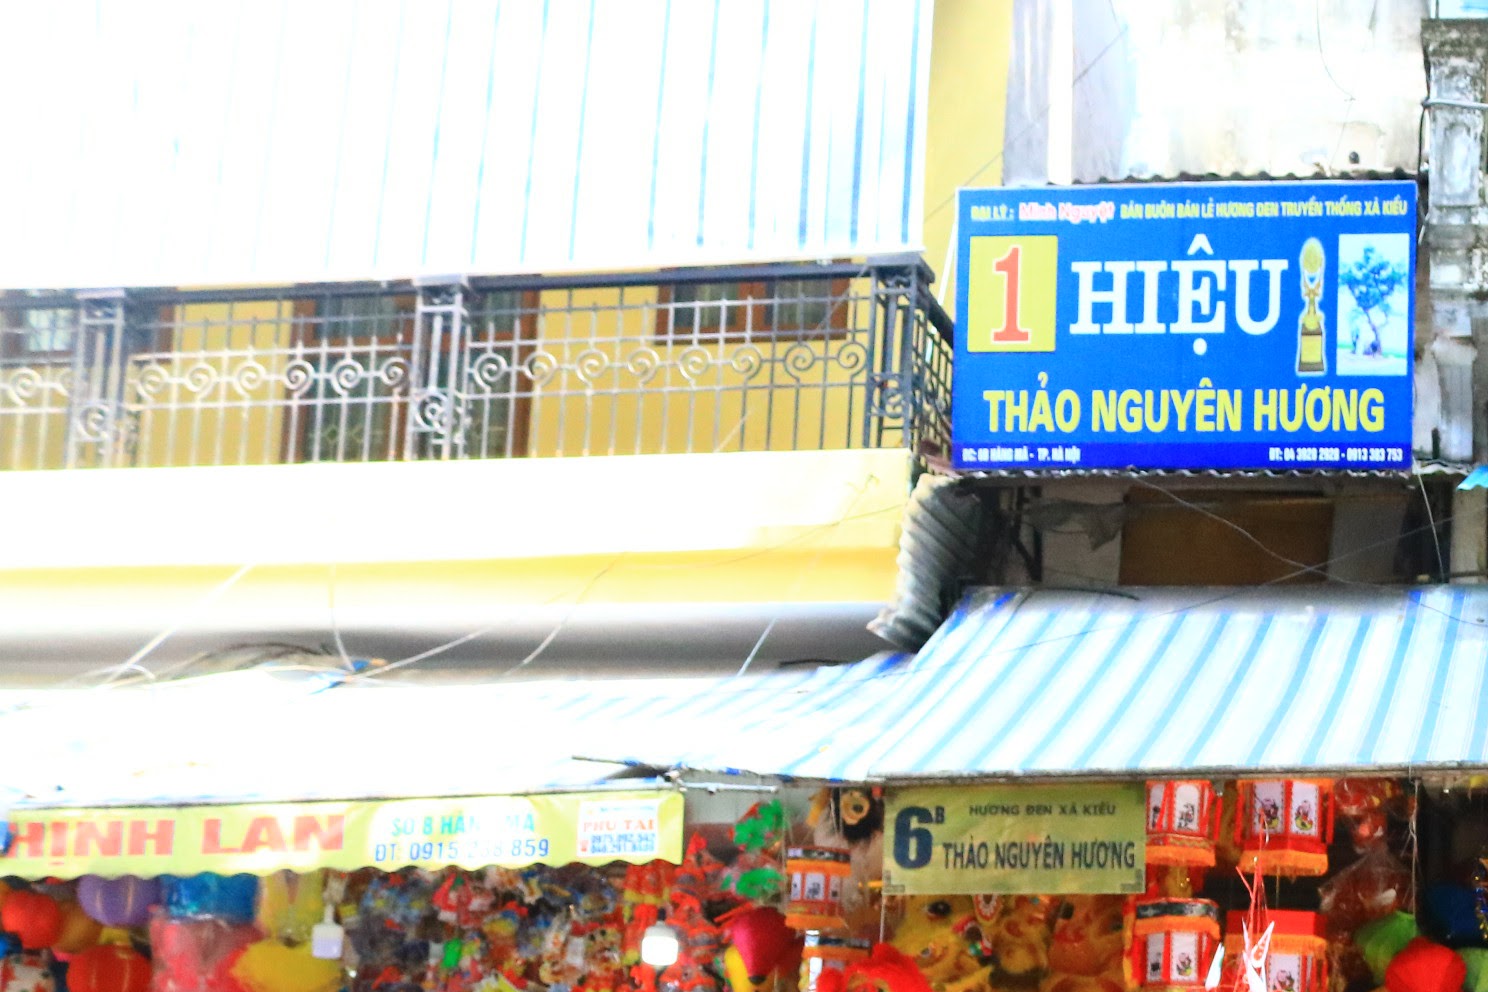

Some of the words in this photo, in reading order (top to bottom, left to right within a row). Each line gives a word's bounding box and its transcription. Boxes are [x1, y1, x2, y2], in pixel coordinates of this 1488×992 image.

[992, 245, 1031, 344] 1
[1069, 233, 1288, 356] HIỆU
[983, 372, 1081, 433] THẢO
[1091, 378, 1242, 433] NGUYÊN
[1253, 383, 1385, 433] HƯƠNG
[969, 803, 1020, 816] HƯƠNG
[1026, 804, 1052, 816] ĐEN
[202, 814, 345, 855] LAN
[409, 842, 459, 861] 0915
[511, 838, 549, 858] 859
[995, 835, 1064, 869] NGUYÊN
[1071, 837, 1135, 869] HƯƠNG
